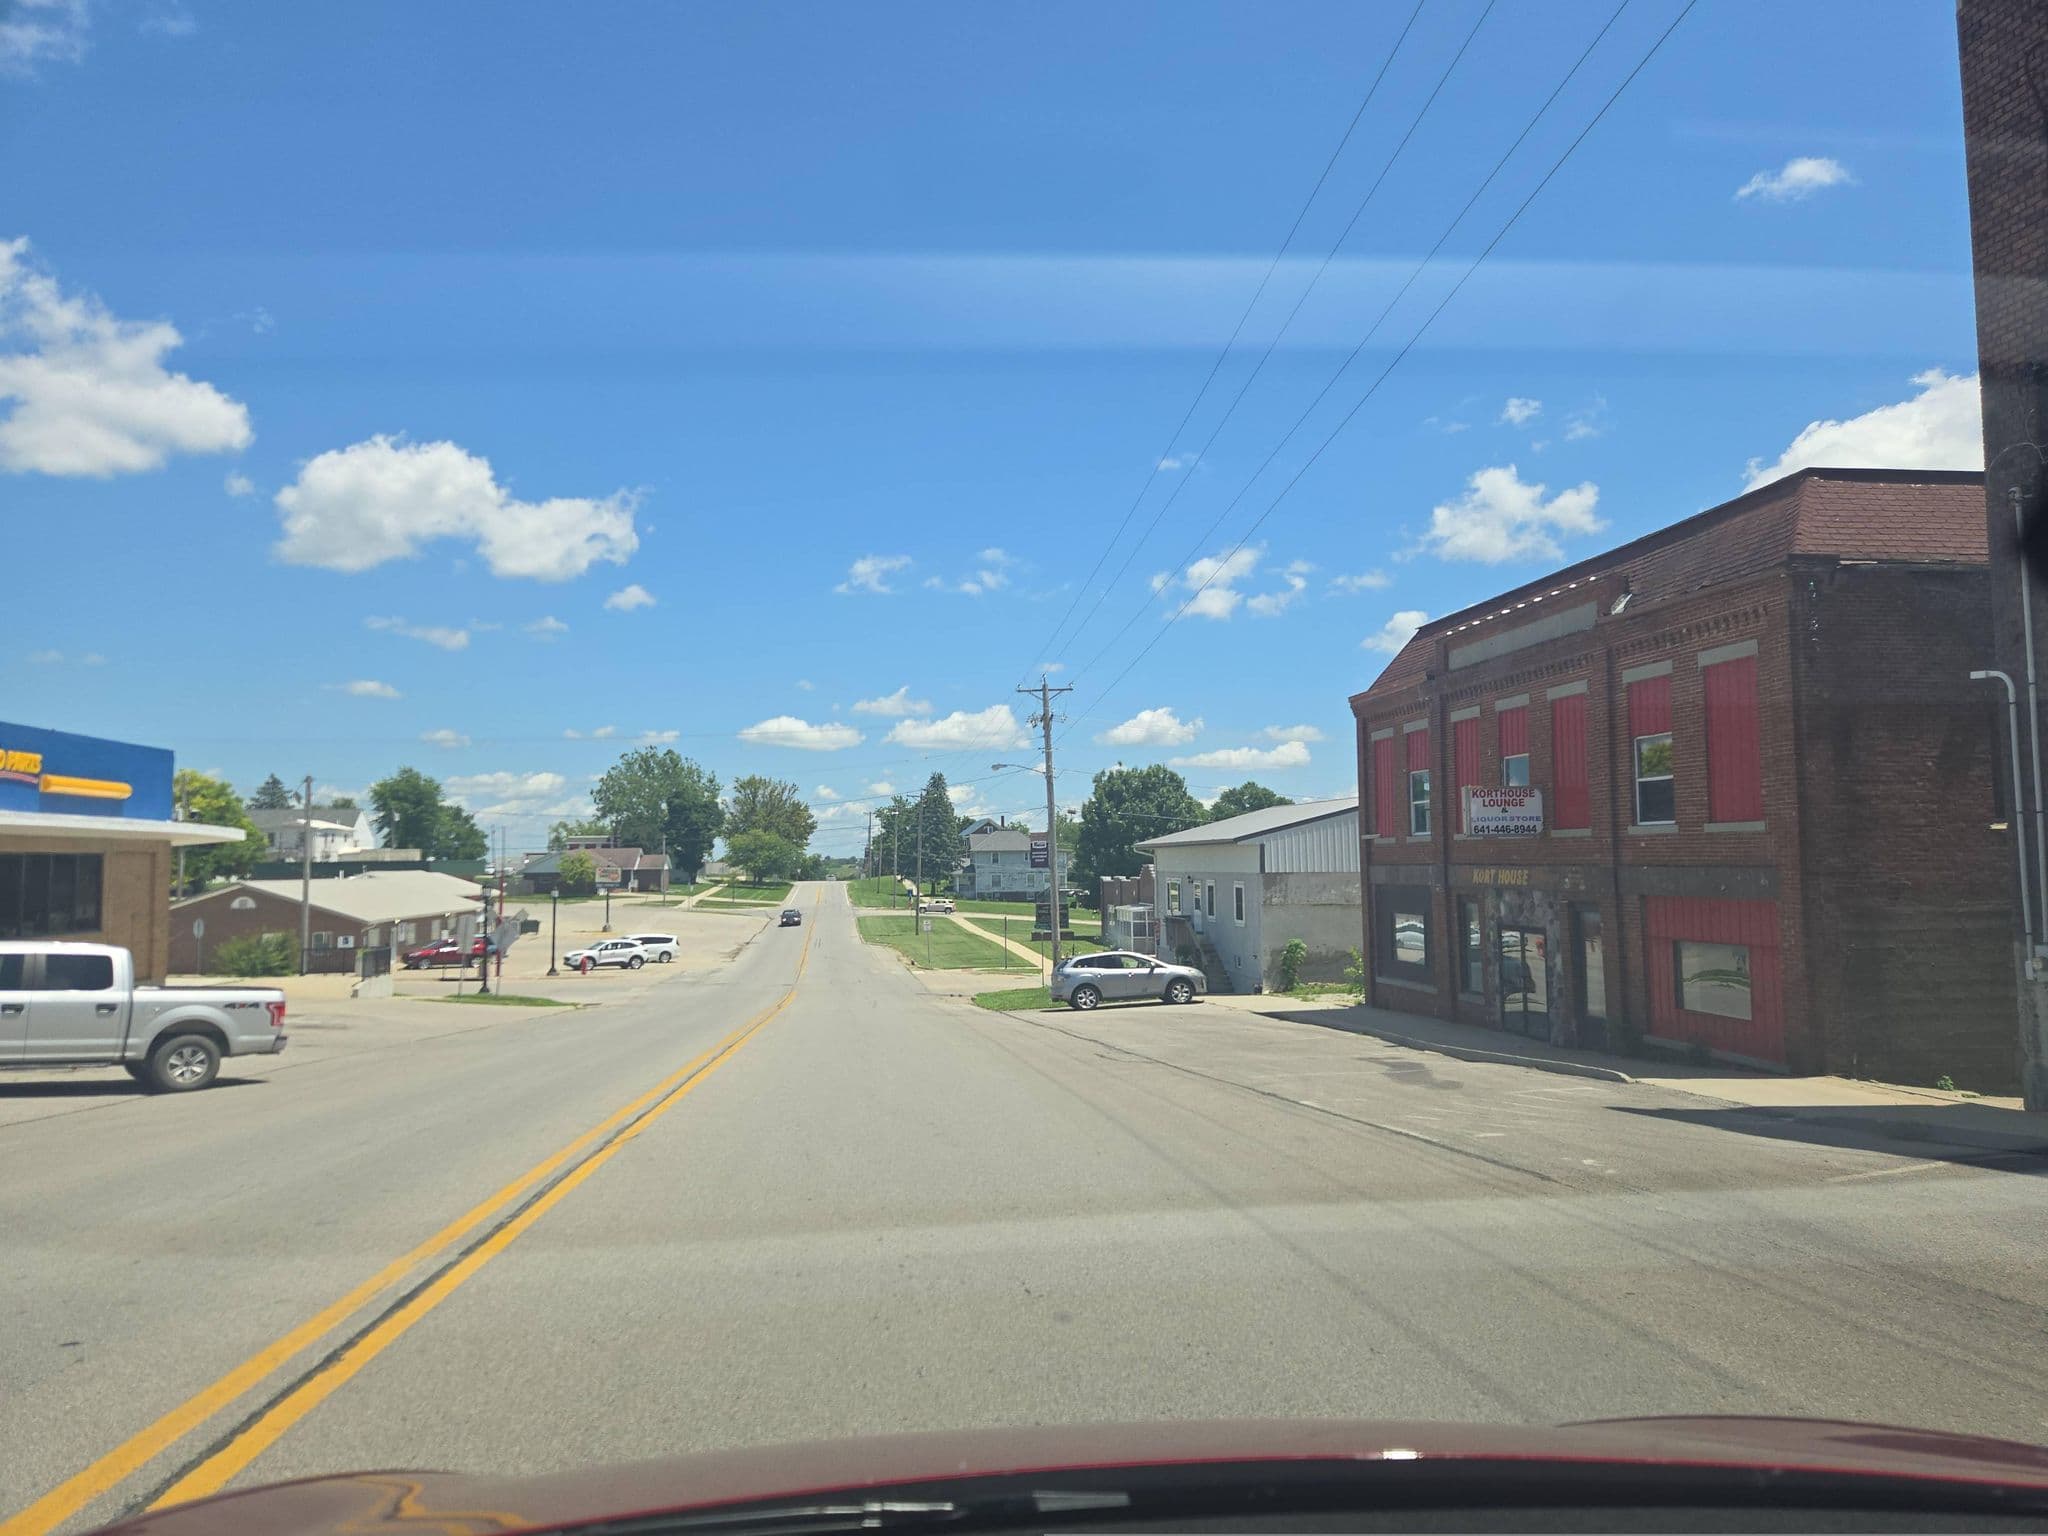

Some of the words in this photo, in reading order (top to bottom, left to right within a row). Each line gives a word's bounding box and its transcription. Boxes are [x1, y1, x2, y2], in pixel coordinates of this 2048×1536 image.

[1472, 789, 1535, 798] KORTHOUSE
[1482, 798, 1525, 807] LOUNGE
[1471, 815, 1509, 823] LIQUOR
[1474, 825, 1537, 833] 641-446-8944
[1472, 868, 1496, 885] KORT
[1497, 868, 1529, 886] HOUSE
